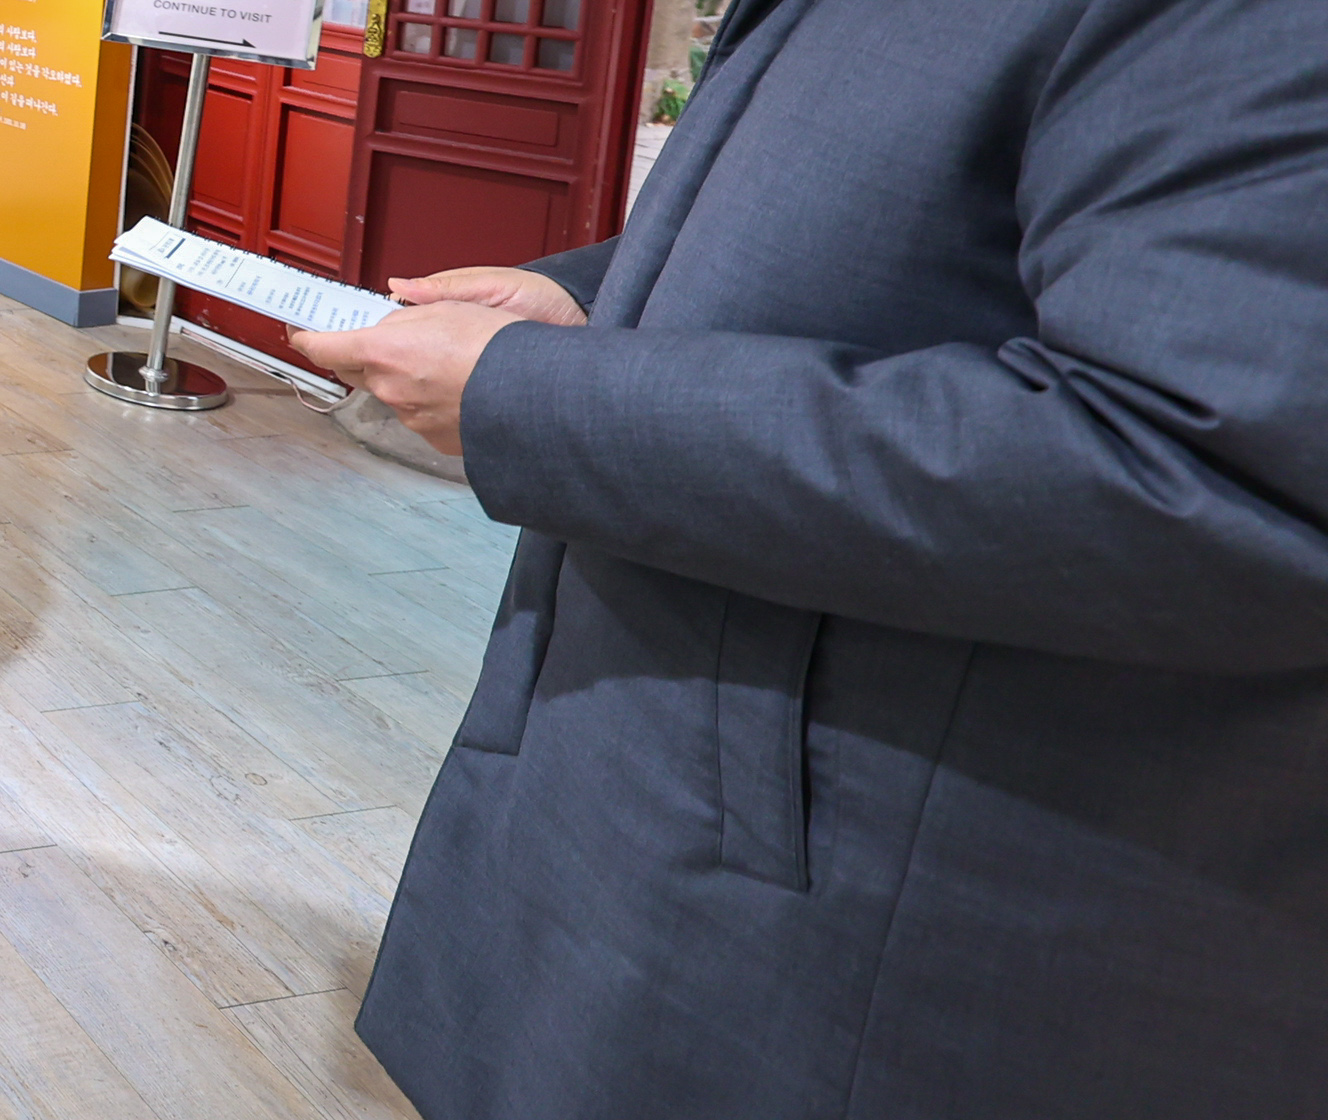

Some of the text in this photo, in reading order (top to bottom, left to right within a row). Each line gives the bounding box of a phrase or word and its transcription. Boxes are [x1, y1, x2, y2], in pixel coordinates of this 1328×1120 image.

[153, 0, 273, 24] CONTINUE TO VISIT
